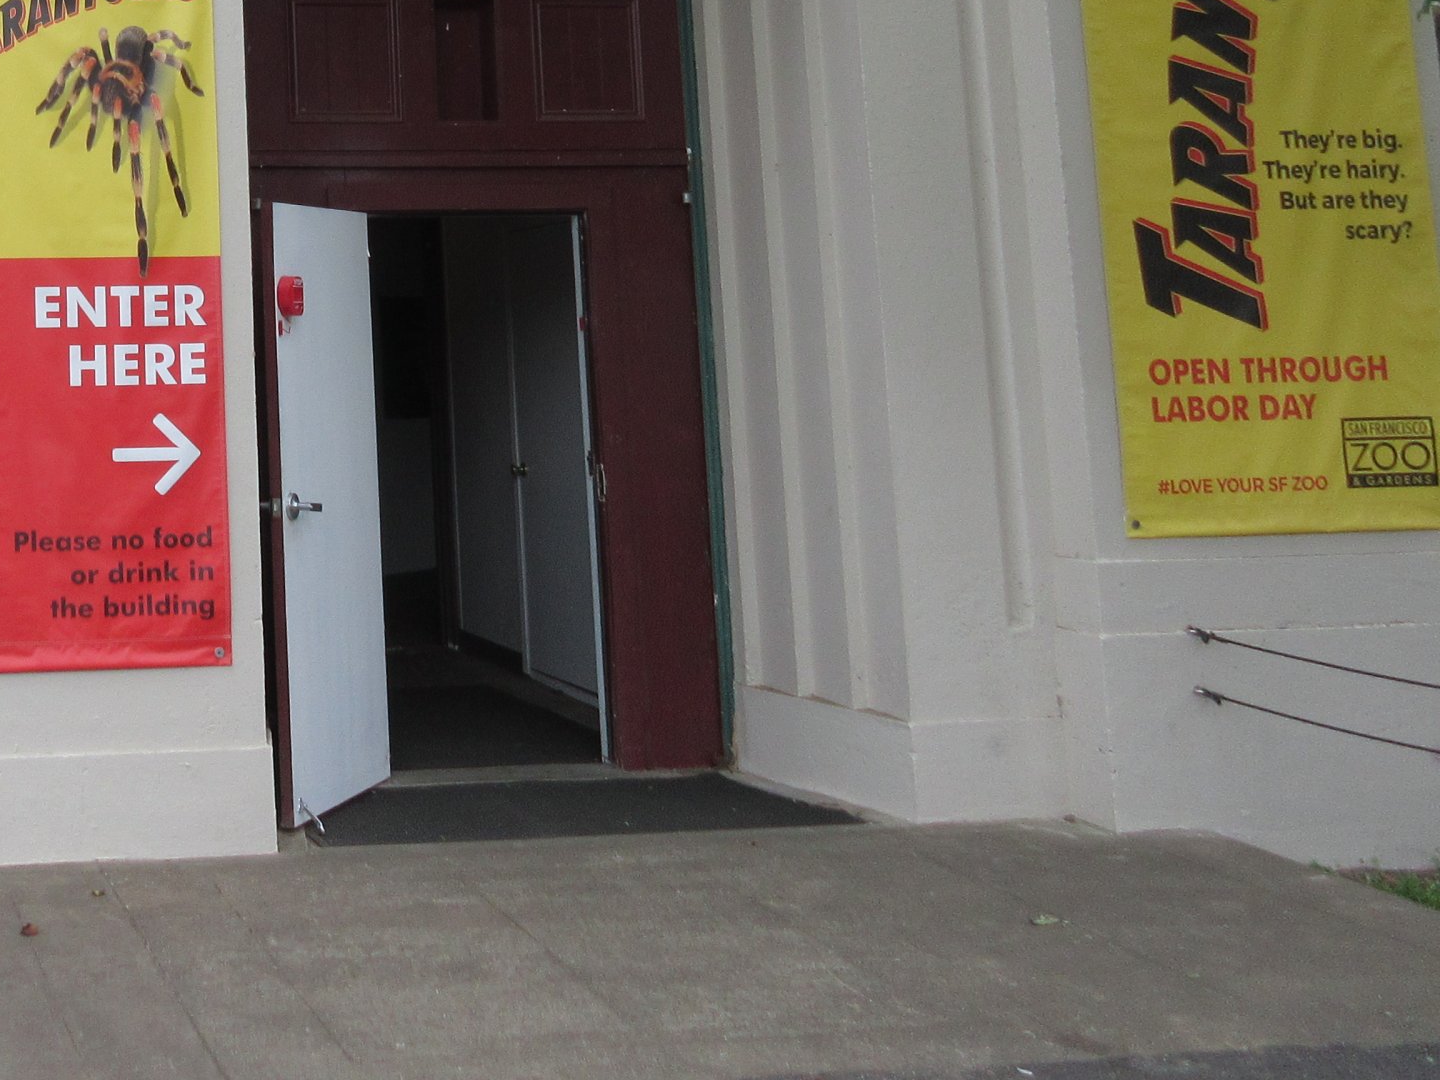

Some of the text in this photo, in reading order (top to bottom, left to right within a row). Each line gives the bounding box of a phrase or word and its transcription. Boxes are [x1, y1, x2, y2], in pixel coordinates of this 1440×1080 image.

[1279, 128, 1403, 154] They're big.
[1262, 159, 1406, 184] They're hairy.
[1279, 188, 1409, 213] But are they
[1345, 220, 1413, 244] scary?
[34, 284, 208, 329] ENTER
[69, 342, 207, 387] HERE
[1149, 355, 1389, 385] OPEN THROUGH
[1151, 393, 1317, 422] LABOR DAY
[1348, 421, 1428, 435] SAN FRANCISCO
[1350, 441, 1431, 471] ZOO
[1158, 477, 1213, 494] #LOVE
[1292, 475, 1328, 491] ZOO
[1365, 474, 1432, 486] GARDENS
[14, 525, 214, 553] Please no food
[70, 559, 215, 585] or drink in
[50, 593, 216, 620] the building
